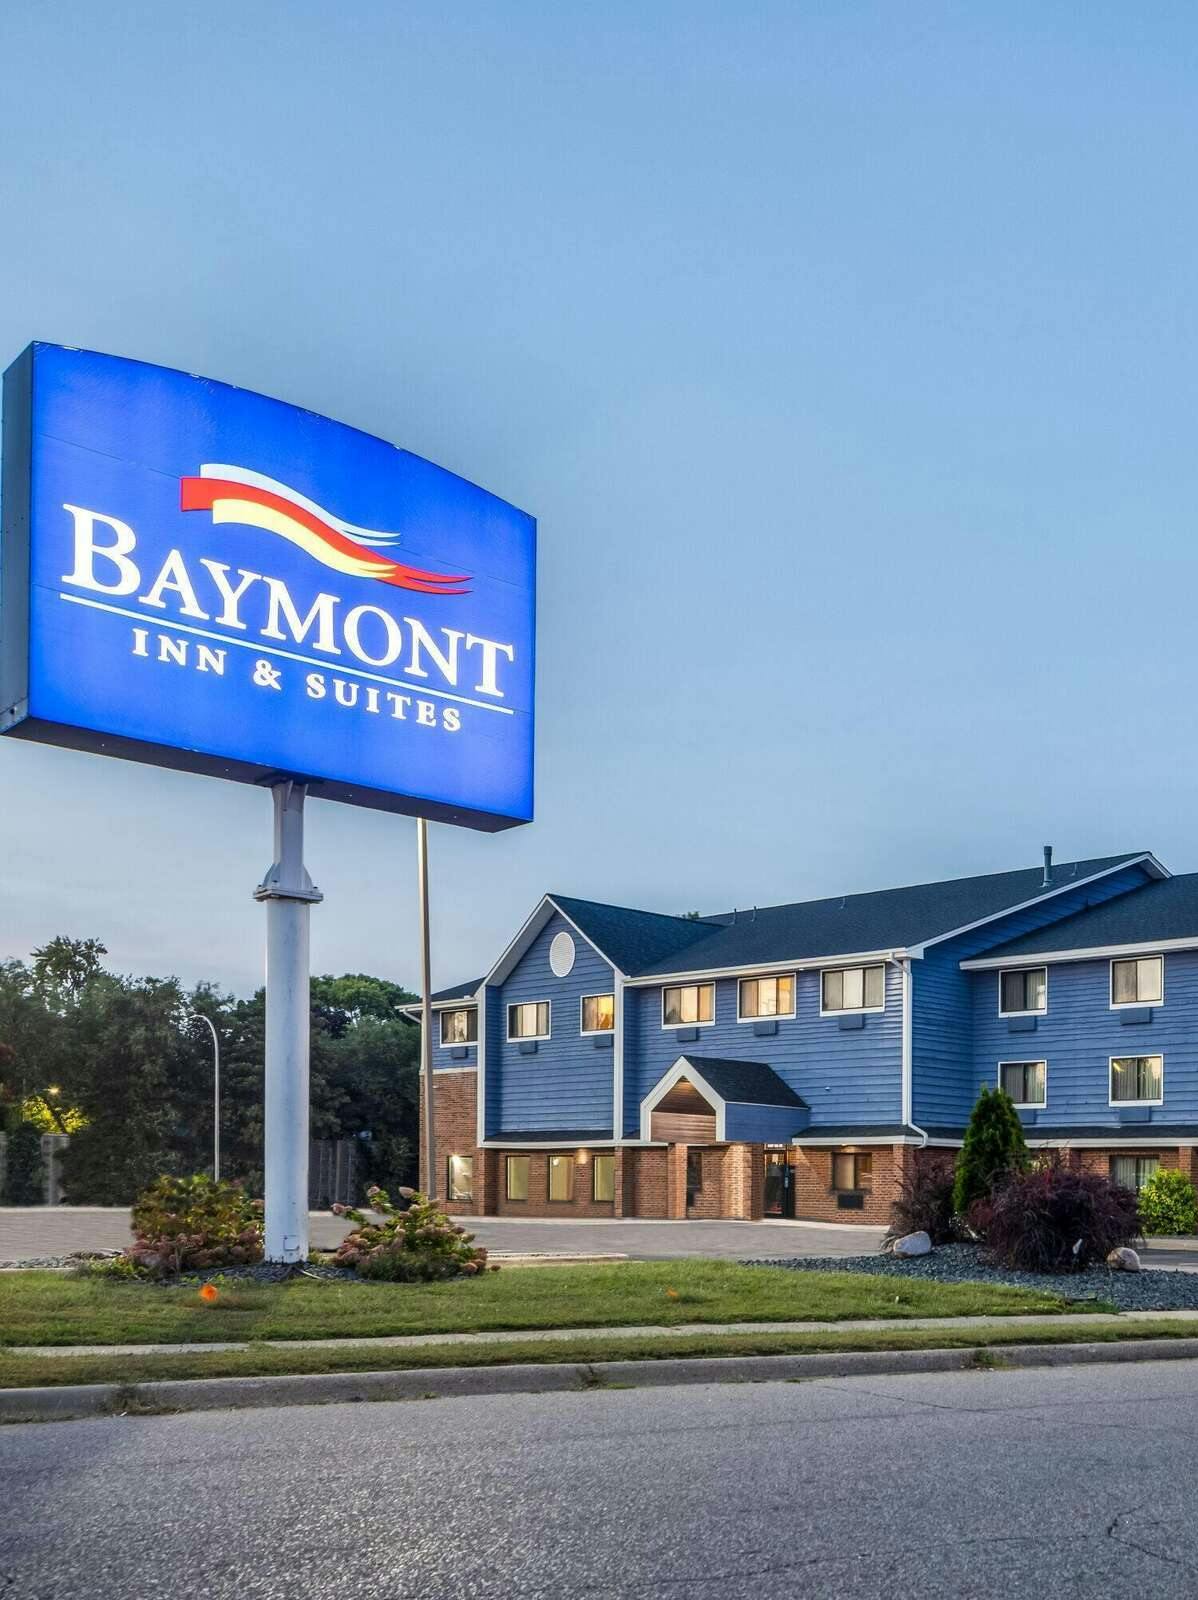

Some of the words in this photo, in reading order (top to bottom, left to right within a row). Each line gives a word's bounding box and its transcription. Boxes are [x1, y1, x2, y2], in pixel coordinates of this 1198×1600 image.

[61, 503, 515, 698] BAYMONT
[132, 628, 227, 676] INN
[252, 659, 282, 691] &
[306, 673, 462, 732] SUITES
